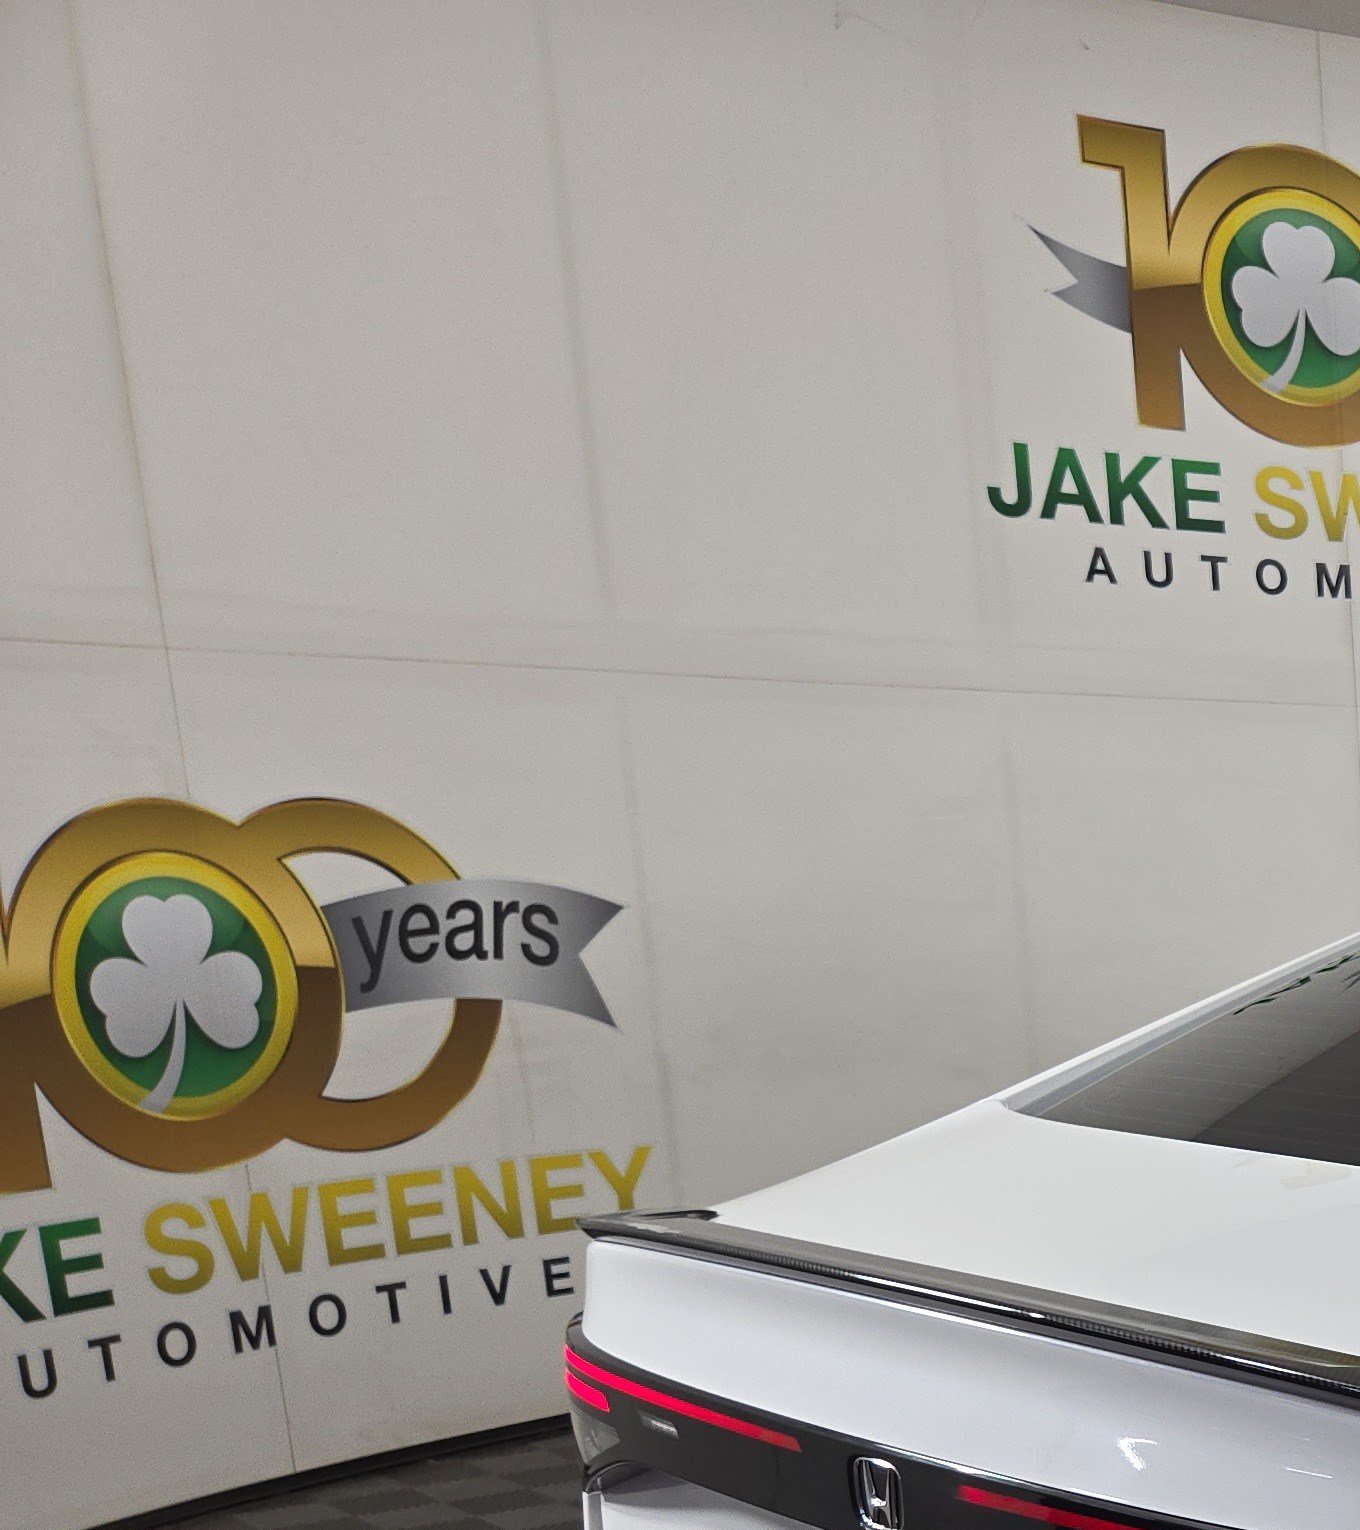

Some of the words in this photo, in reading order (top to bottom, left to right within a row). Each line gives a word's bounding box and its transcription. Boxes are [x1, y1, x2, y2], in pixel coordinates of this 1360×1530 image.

[987, 441, 1226, 534] JAKE
[351, 898, 560, 993] years
[144, 1145, 653, 1295] SWEENEY
[17, 1256, 575, 1399] UTOMOTIVE
